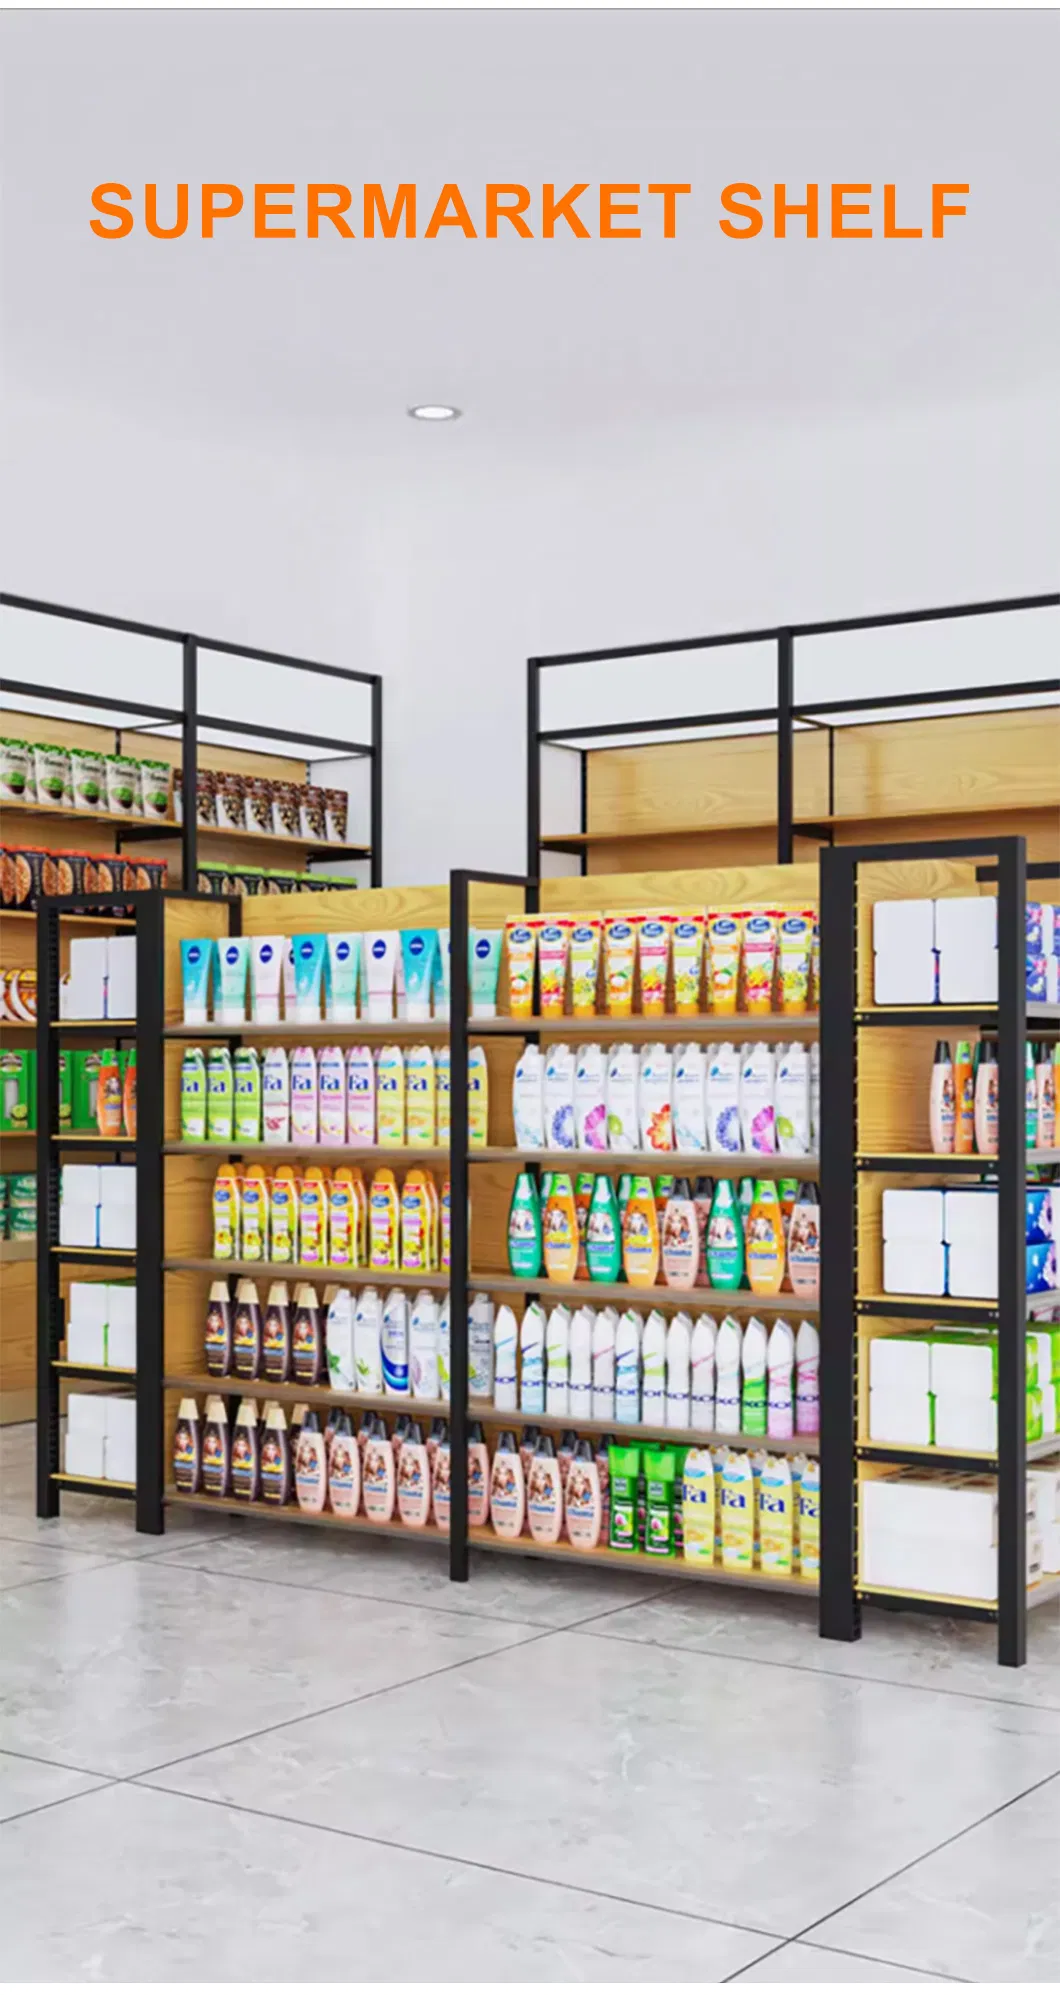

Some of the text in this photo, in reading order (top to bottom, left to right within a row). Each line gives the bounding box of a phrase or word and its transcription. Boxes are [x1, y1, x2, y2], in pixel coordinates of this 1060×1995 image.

[263, 1074, 282, 1090] Fa
[292, 1074, 311, 1090] Fa
[321, 1074, 340, 1090] Fa
[349, 1074, 368, 1090] Fa
[682, 1484, 707, 1503] Fa
[721, 1488, 746, 1508] Fa
[760, 1493, 785, 1513] Fa
